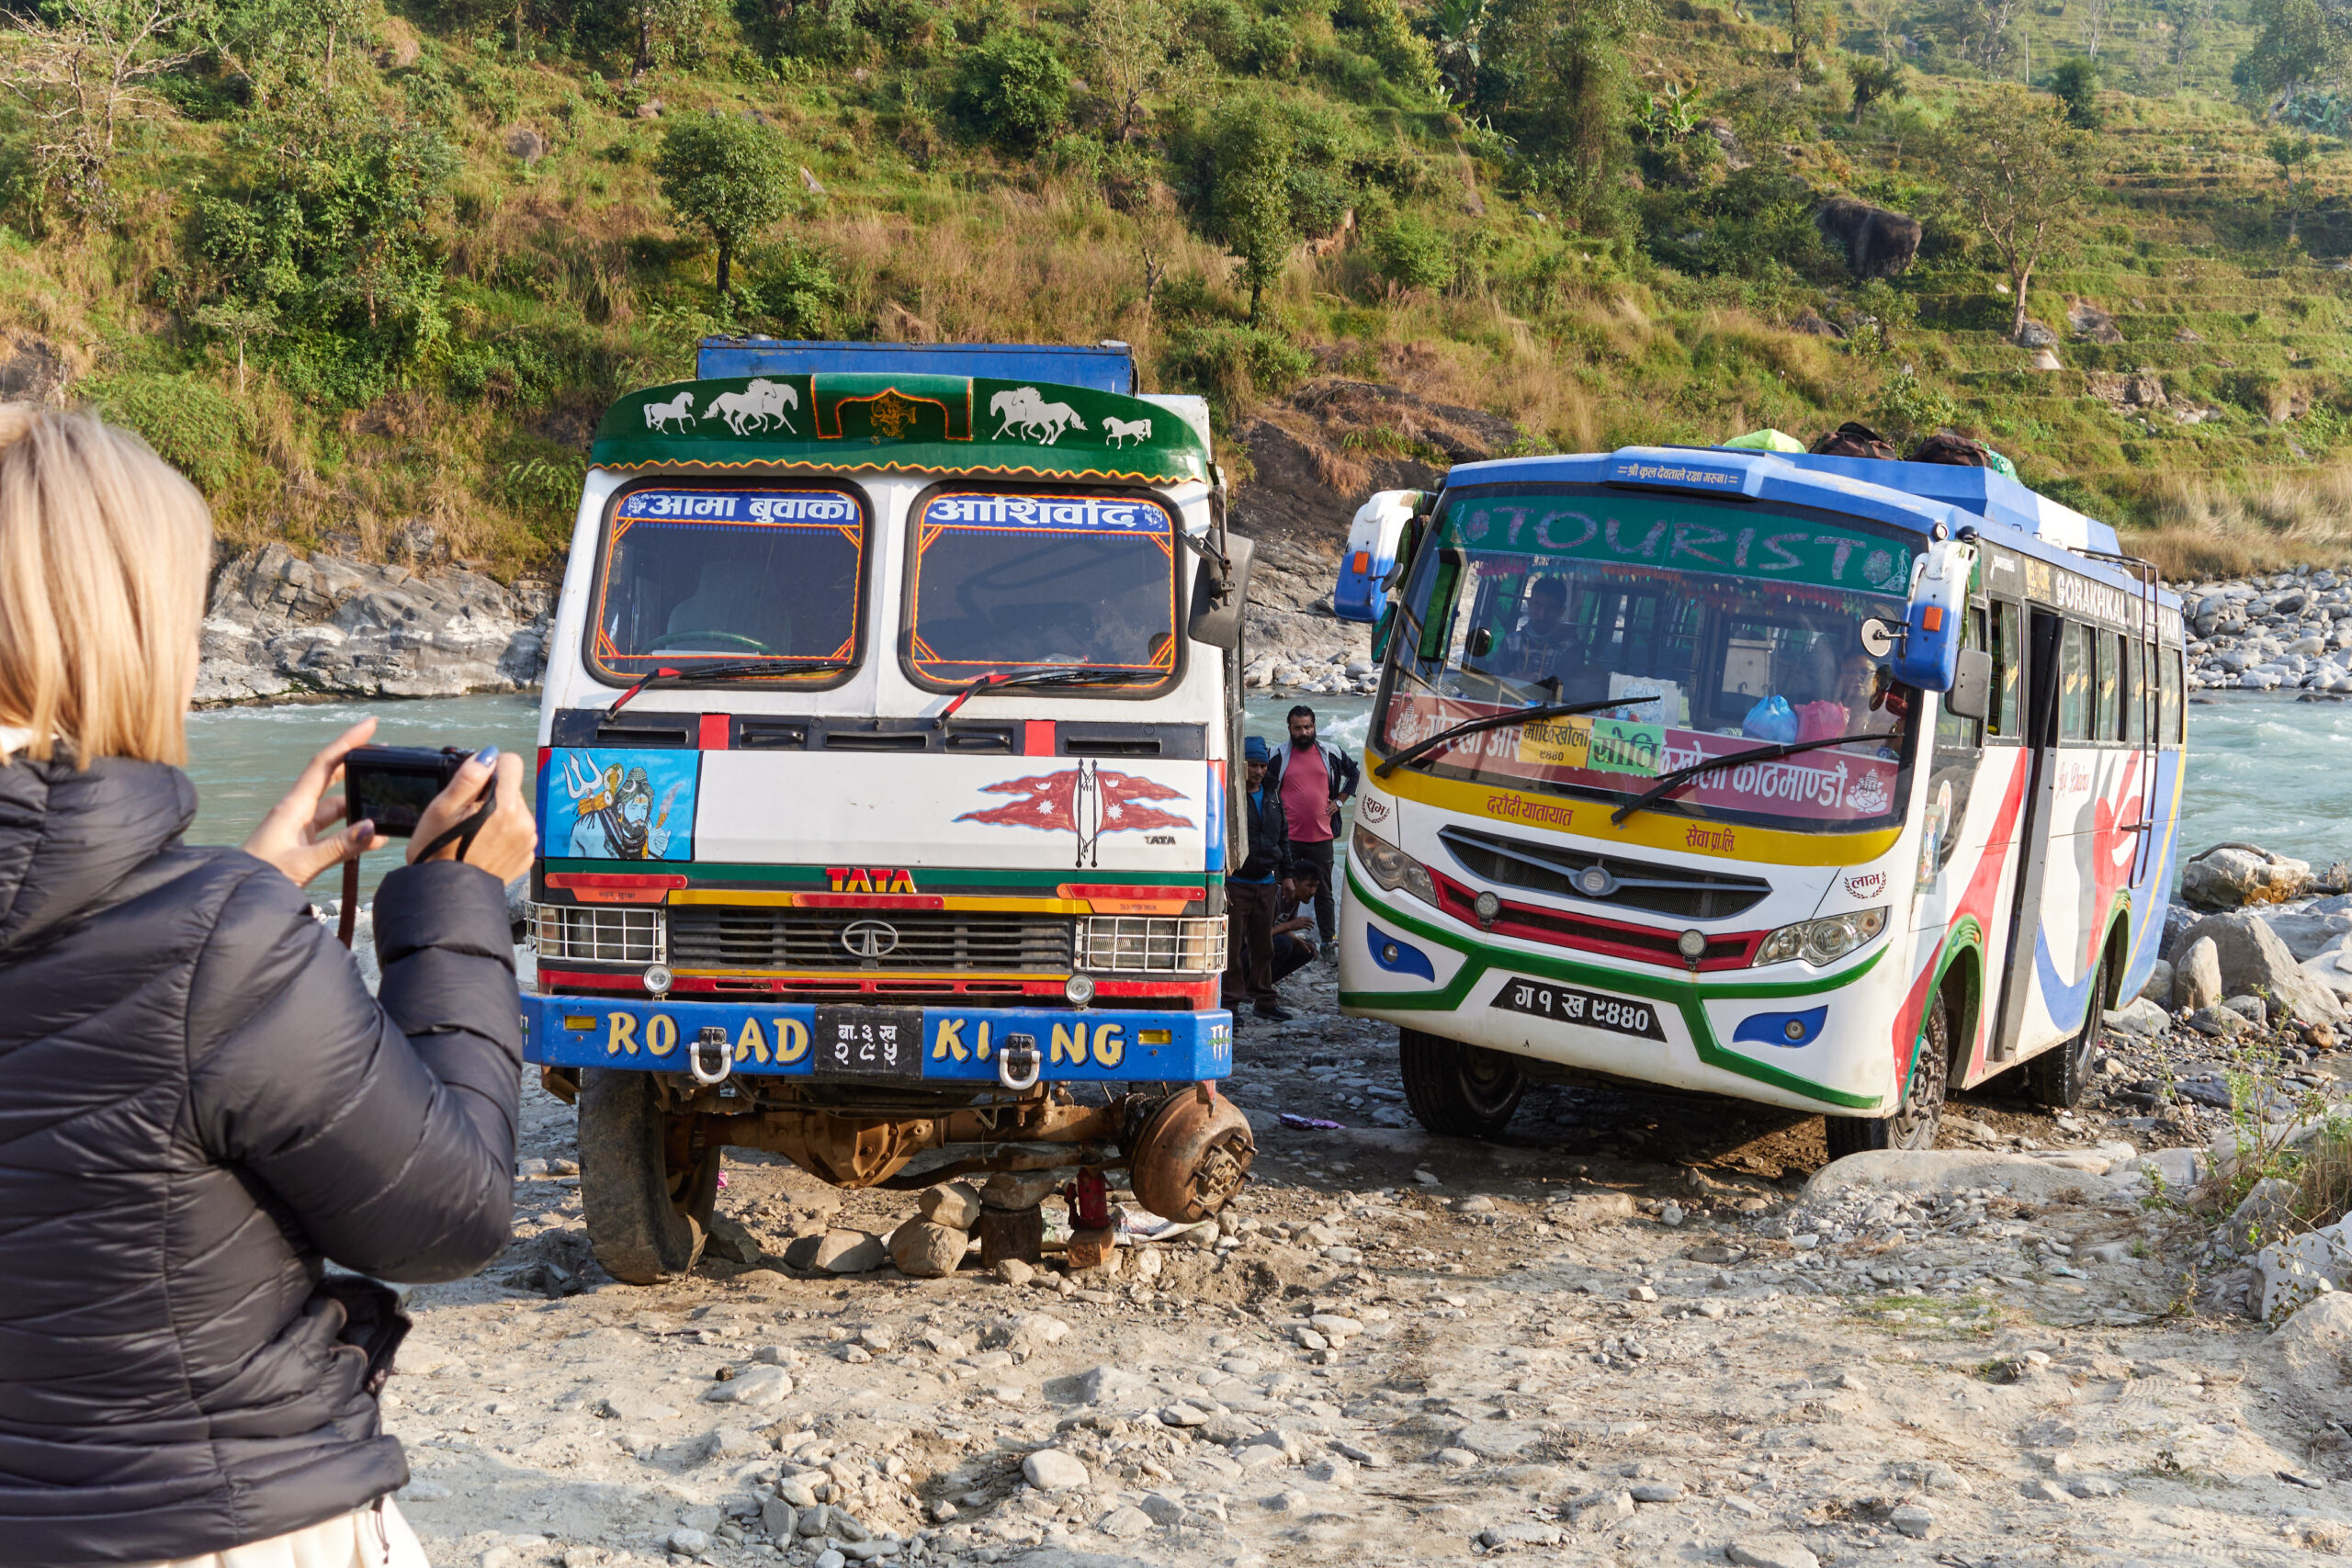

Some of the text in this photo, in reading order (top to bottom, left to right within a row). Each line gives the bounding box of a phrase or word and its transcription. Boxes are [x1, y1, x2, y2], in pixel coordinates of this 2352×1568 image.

[648, 494, 856, 524] आमा बुवाको
[928, 496, 1140, 527] आशिर्वाद
[1492, 504, 1868, 581] TOURIST
[1366, 797, 1387, 816] शुभ
[1487, 793, 1575, 827] दरौदी यातायात
[1144, 835, 1177, 845] TATA
[1685, 824, 1711, 849] सेवा
[826, 867, 917, 894] TATA
[1850, 873, 1881, 889] लाभ
[1515, 985, 1535, 1009] ग
[1539, 990, 1553, 1012] १
[1562, 993, 1588, 1019] ख
